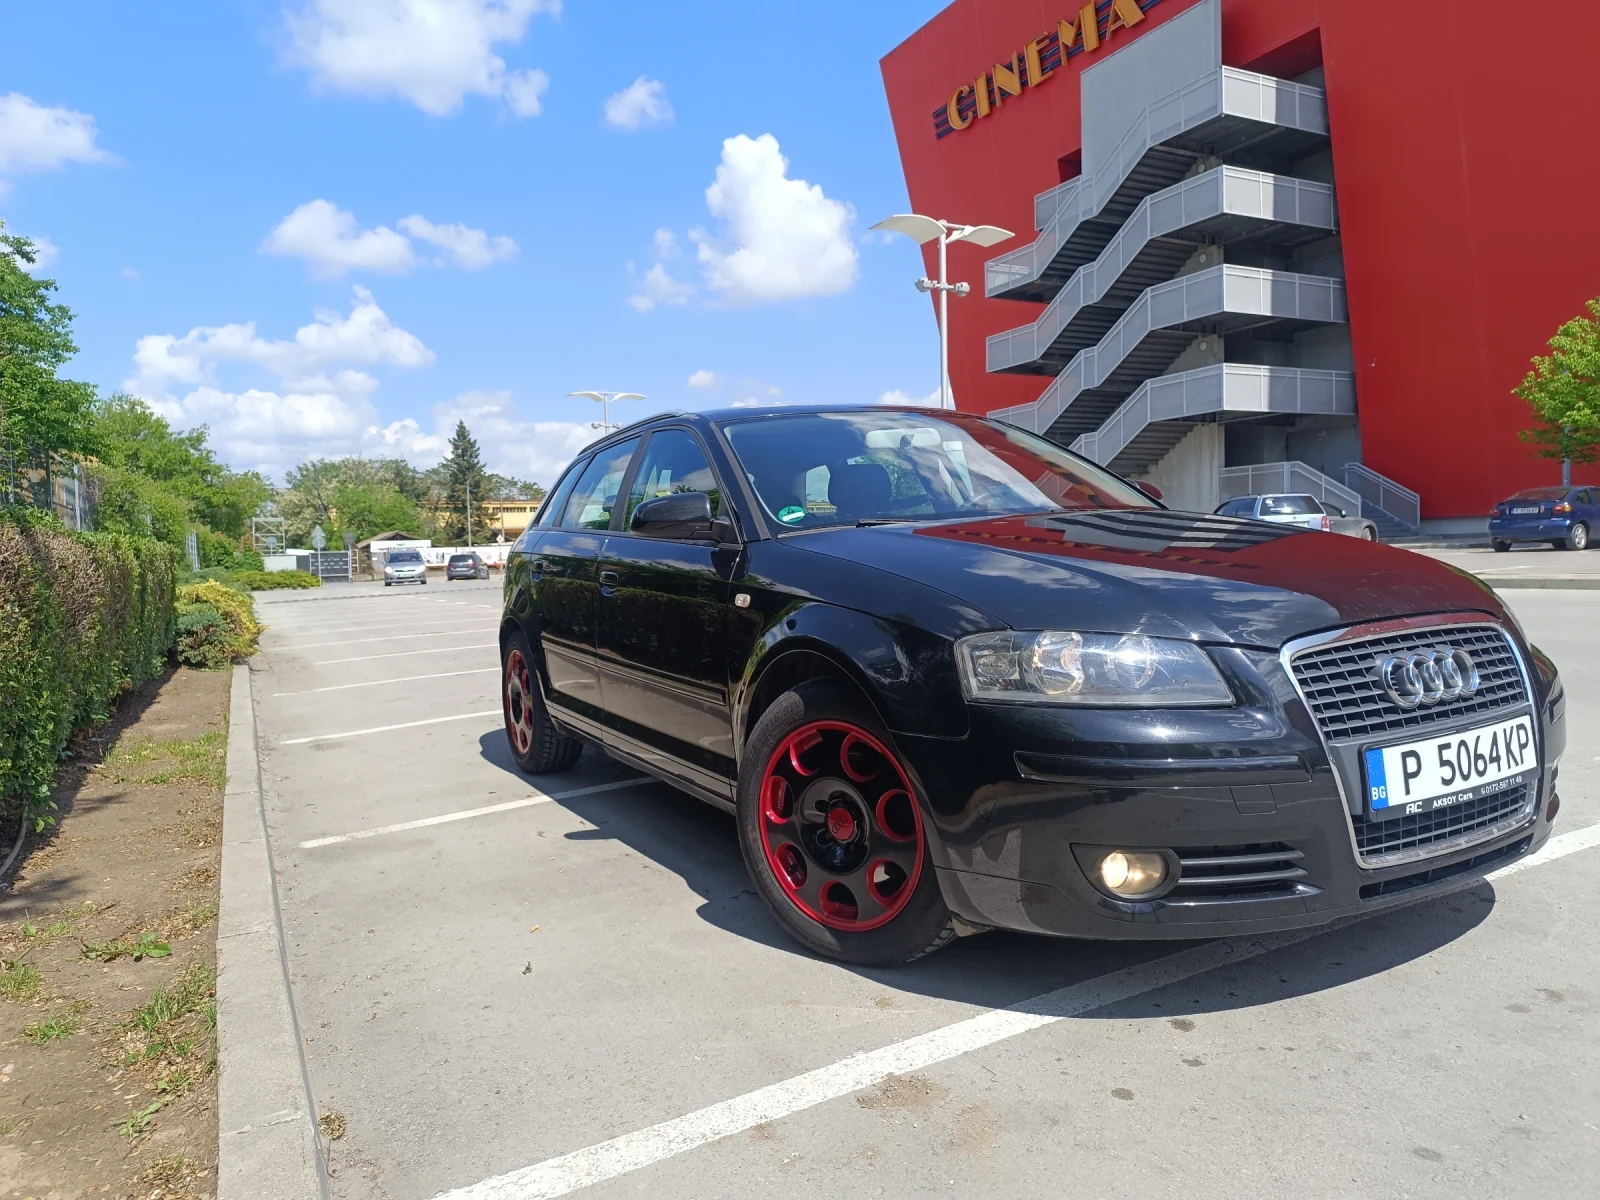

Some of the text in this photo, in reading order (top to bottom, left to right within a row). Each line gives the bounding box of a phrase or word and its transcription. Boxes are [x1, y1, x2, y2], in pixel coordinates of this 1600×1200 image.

[947, 0, 1145, 130] CINEMA
[1401, 749, 1422, 796] P
[1371, 785, 1387, 801] BG
[1432, 794, 1457, 809] AKSOY
[1458, 792, 1473, 802] Cars
